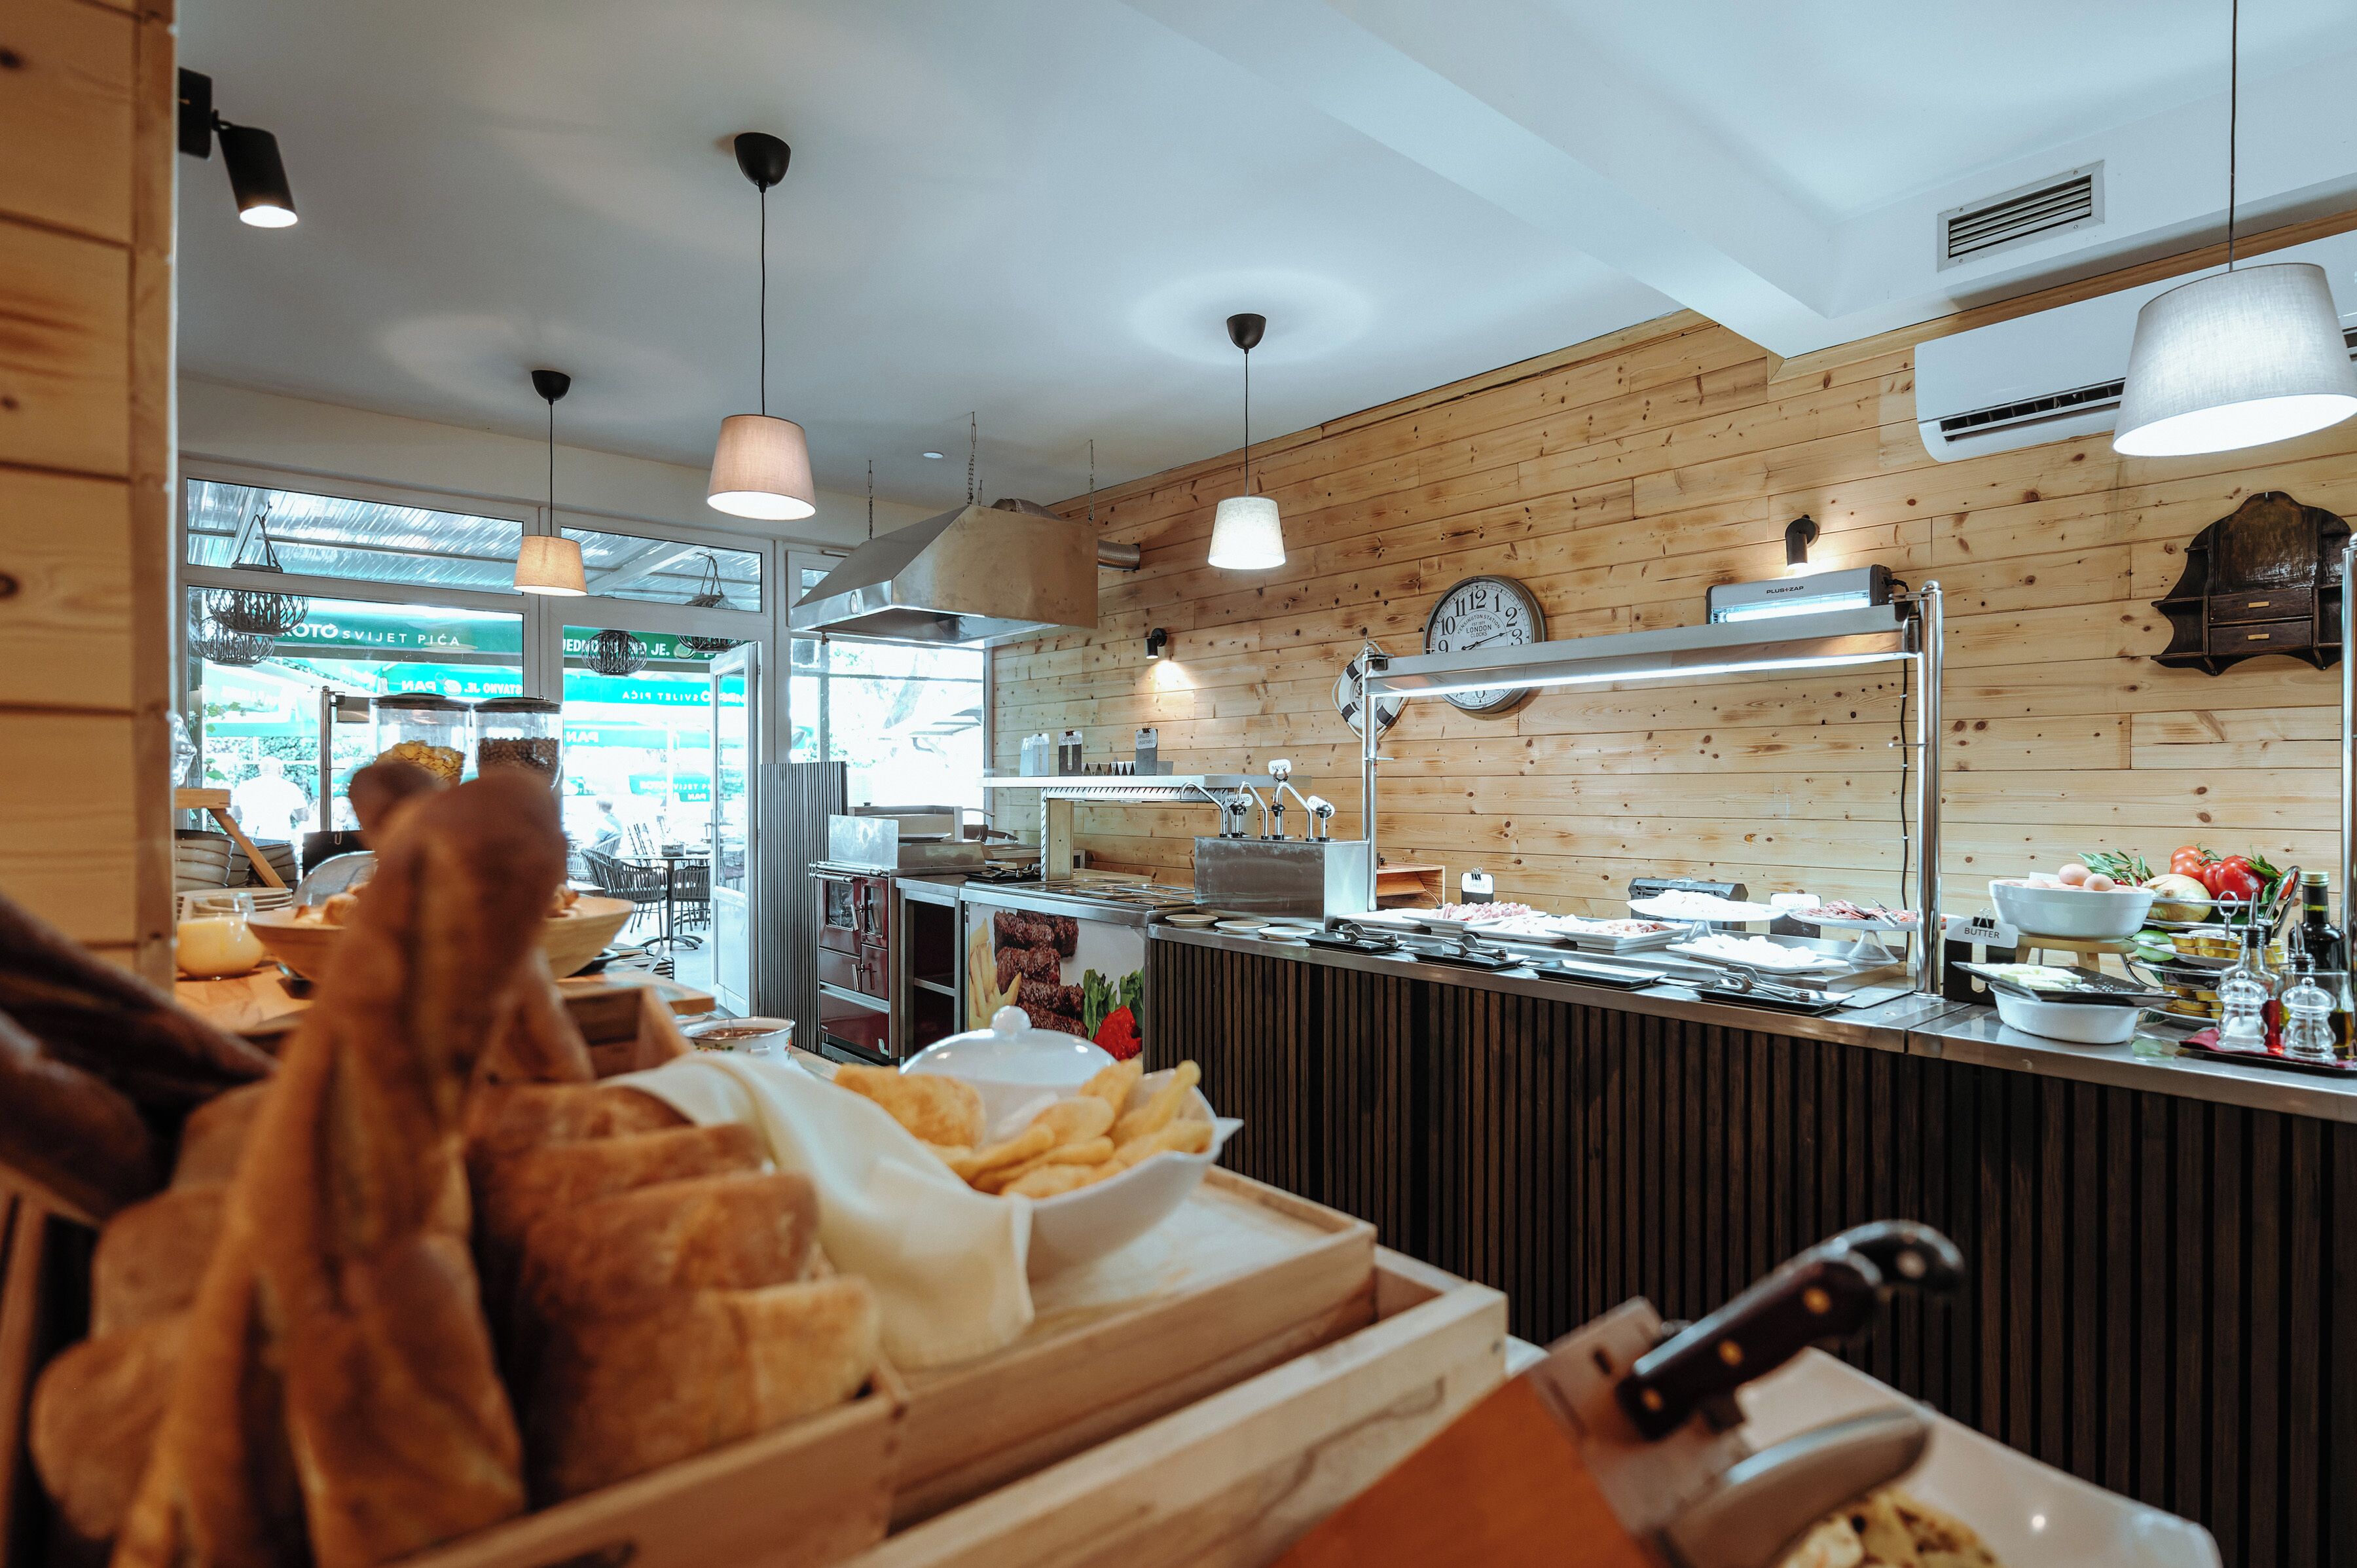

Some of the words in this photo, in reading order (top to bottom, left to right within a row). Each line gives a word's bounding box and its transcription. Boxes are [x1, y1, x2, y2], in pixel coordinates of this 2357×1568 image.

[1455, 597, 1467, 617] 11
[1469, 589, 1486, 610] 12
[1494, 593, 1501, 613] 1
[1440, 616, 1456, 636] 10
[1457, 614, 1483, 634] KENSINGTON
[1484, 614, 1501, 629] STATION
[1505, 607, 1518, 627] 2
[342, 630, 407, 644] SVIJET
[418, 633, 460, 646] PIĆA
[1466, 625, 1492, 633] LONDON
[1510, 629, 1523, 646] 3
[651, 643, 670, 656] JE.
[1964, 927, 2000, 939] BUTTER
